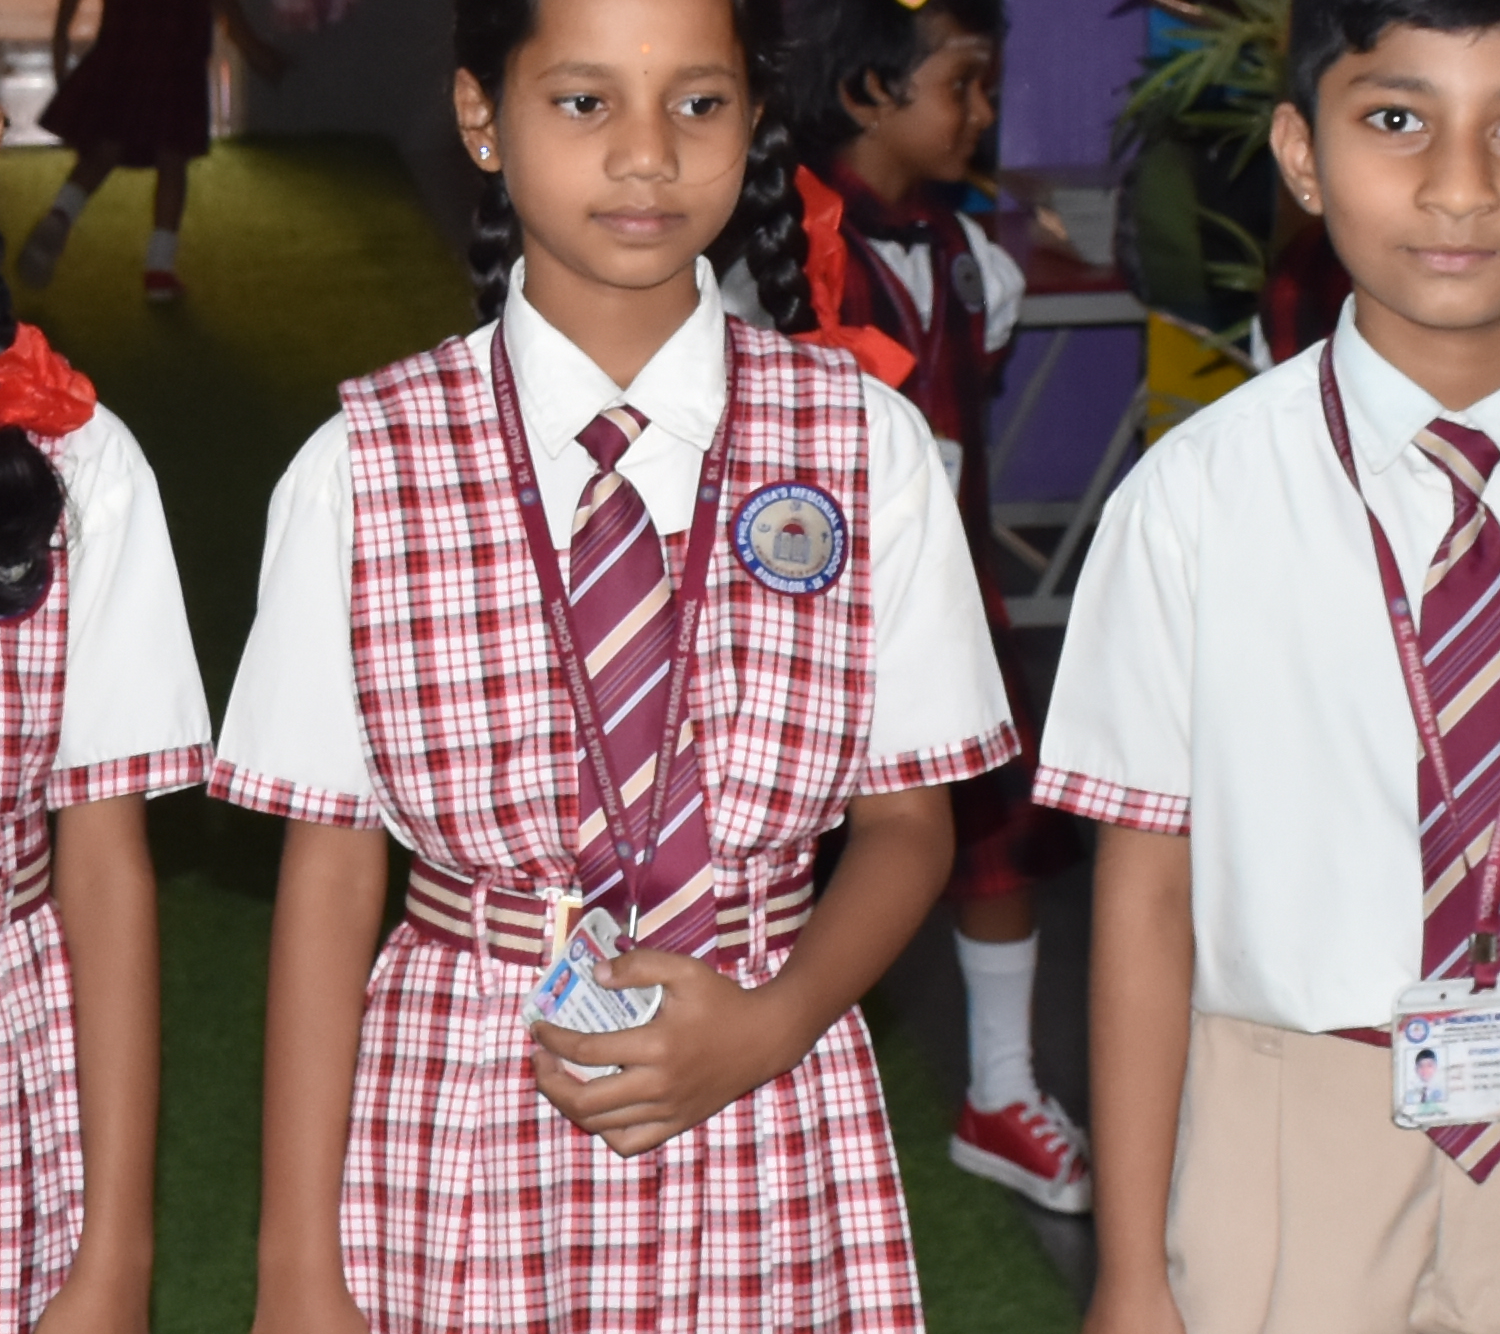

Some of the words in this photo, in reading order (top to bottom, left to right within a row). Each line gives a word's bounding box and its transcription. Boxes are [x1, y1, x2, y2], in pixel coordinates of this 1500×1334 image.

[551, 599, 574, 653] SCHOOL
[666, 656, 687, 726] MEMORIAL
[678, 599, 697, 653] SCHOOL
[565, 654, 594, 729] MEMORIAL
[586, 728, 618, 817] PHILOMENA'S
[1478, 864, 1498, 919] SCHOOL
